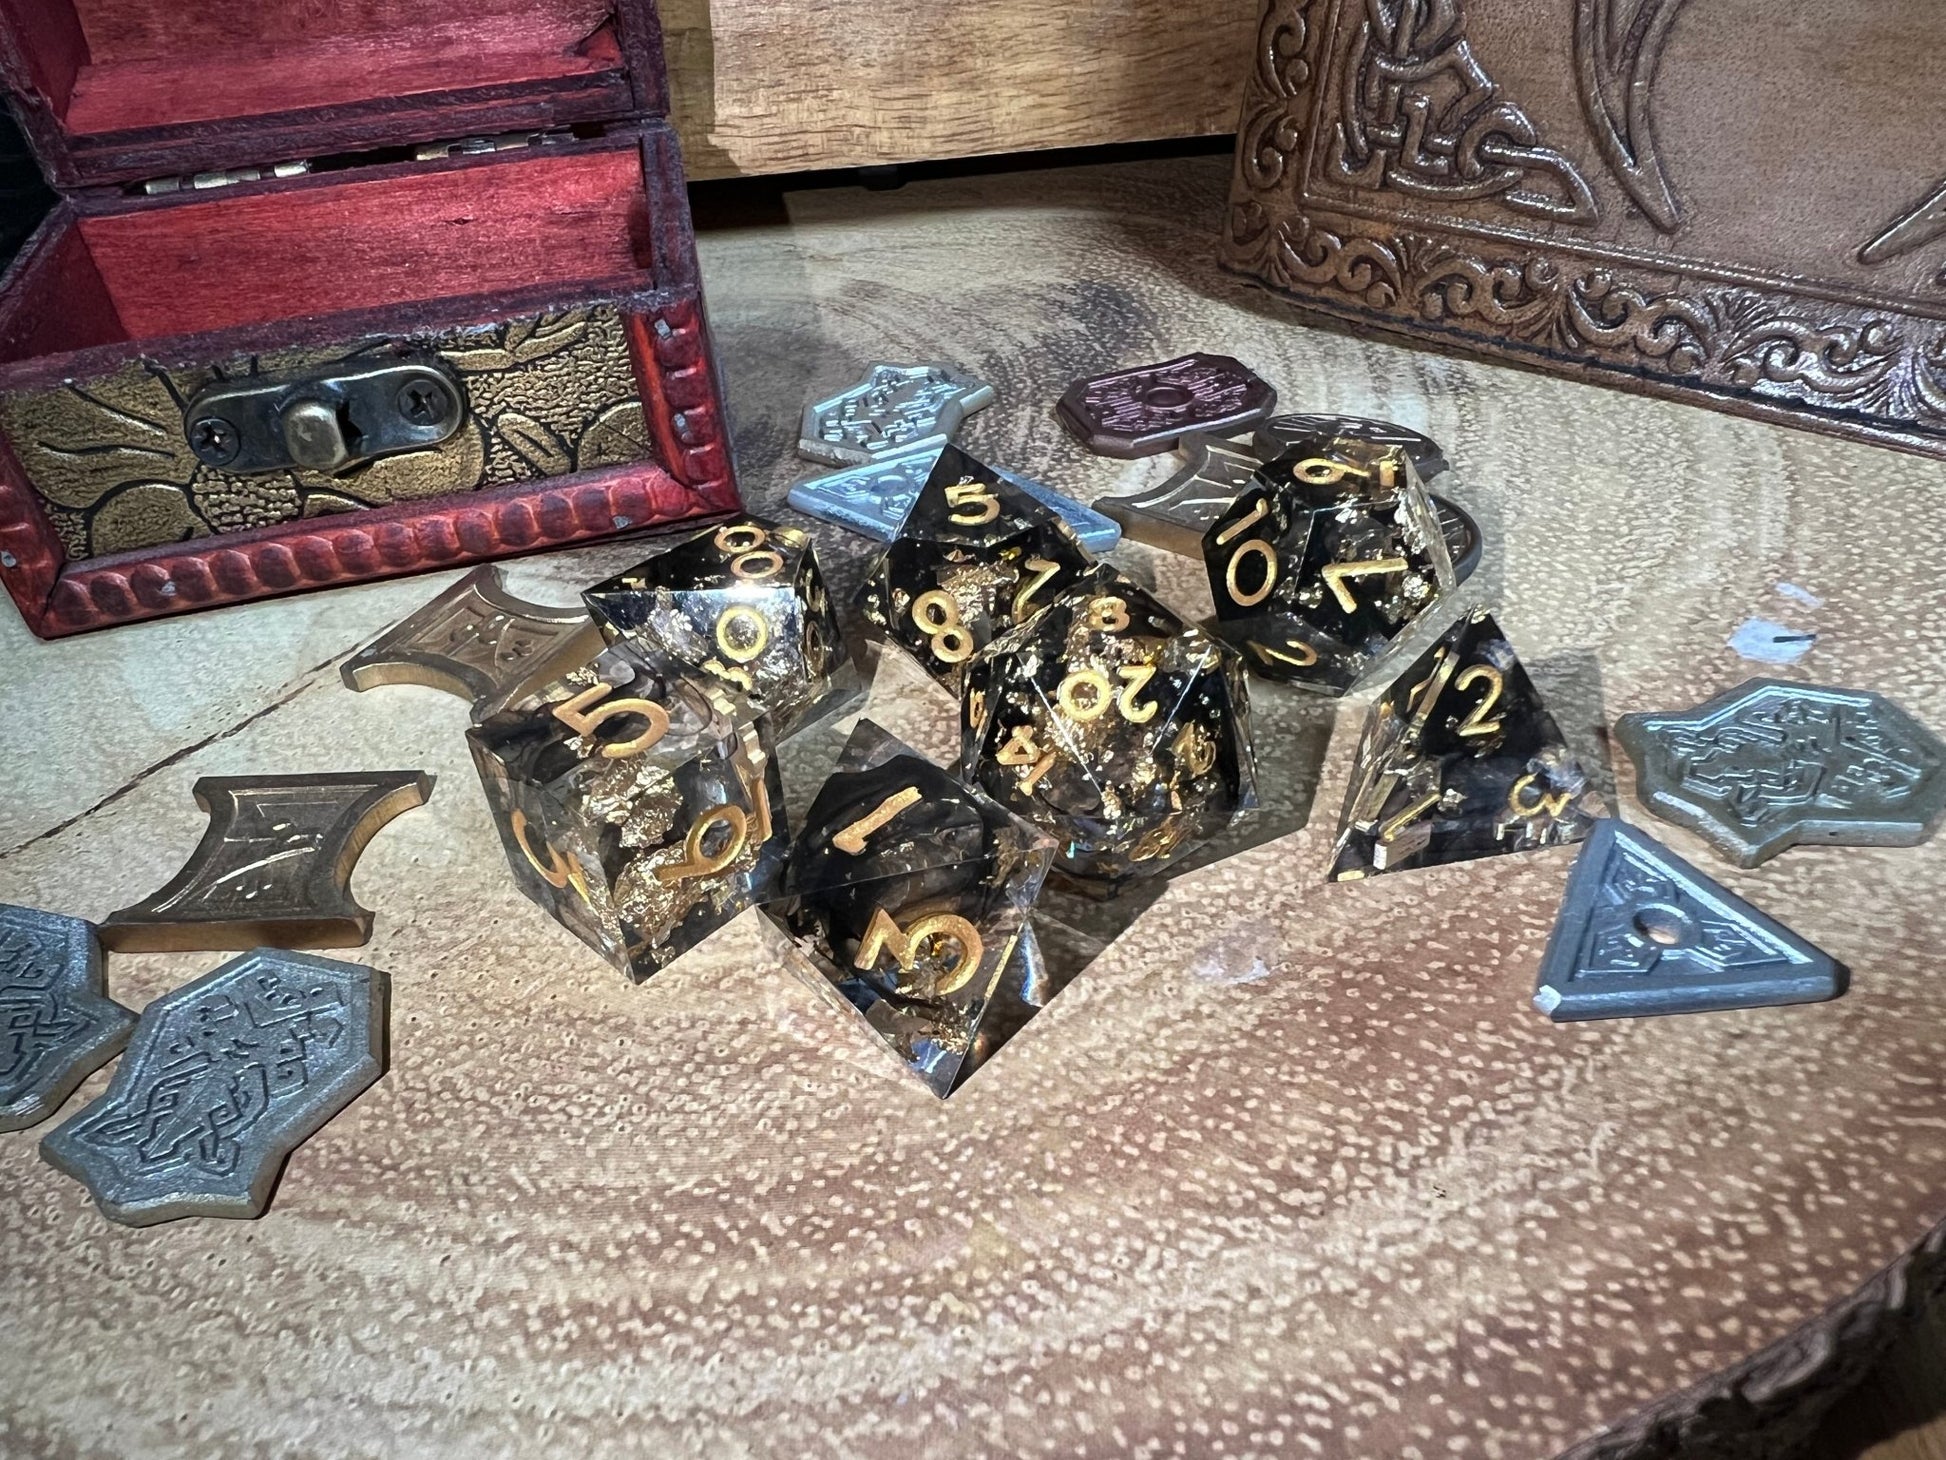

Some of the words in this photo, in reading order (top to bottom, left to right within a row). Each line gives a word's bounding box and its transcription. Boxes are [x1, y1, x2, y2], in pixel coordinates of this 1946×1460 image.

[944, 482, 1001, 527] 5
[1215, 496, 1279, 608] 10
[911, 589, 974, 664] 8
[552, 682, 671, 759] 5
[1057, 664, 1159, 724] 20
[1454, 663, 1504, 737] 2
[832, 786, 924, 856] 1
[854, 907, 984, 997] 3
